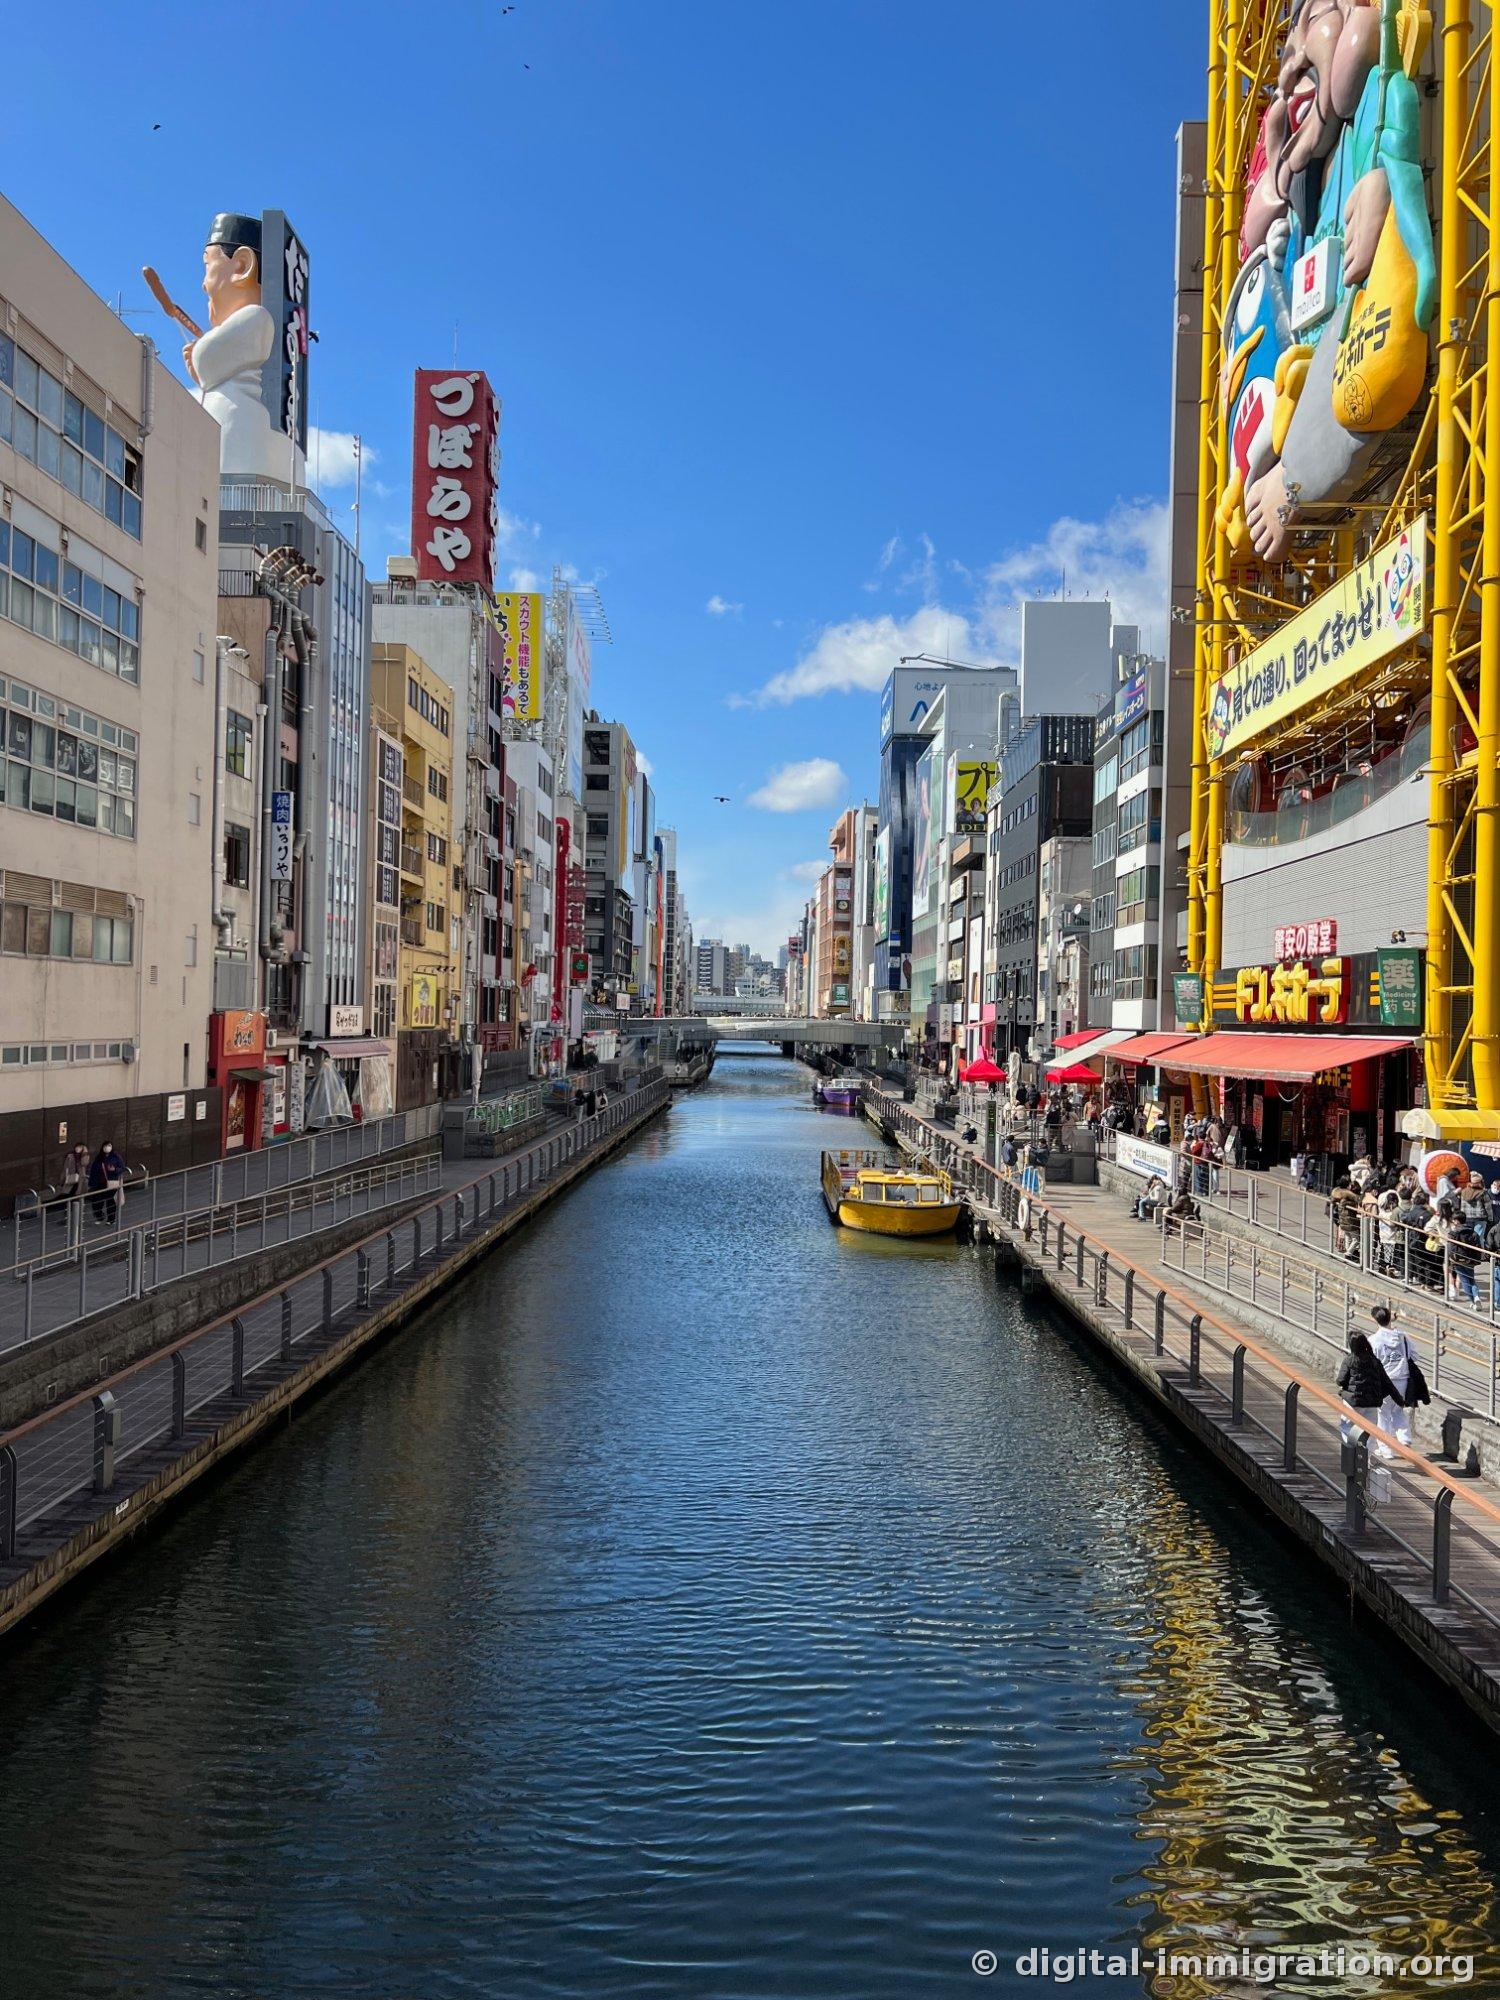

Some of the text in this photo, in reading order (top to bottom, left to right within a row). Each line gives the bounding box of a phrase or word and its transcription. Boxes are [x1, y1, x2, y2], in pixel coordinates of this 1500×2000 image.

[426, 372, 481, 572] づぼらや
[276, 795, 290, 821] 焼肉
[276, 824, 289, 878] いろりや
[1274, 921, 1332, 960] 驚安の殿堂
[1383, 958, 1416, 990] 薬
